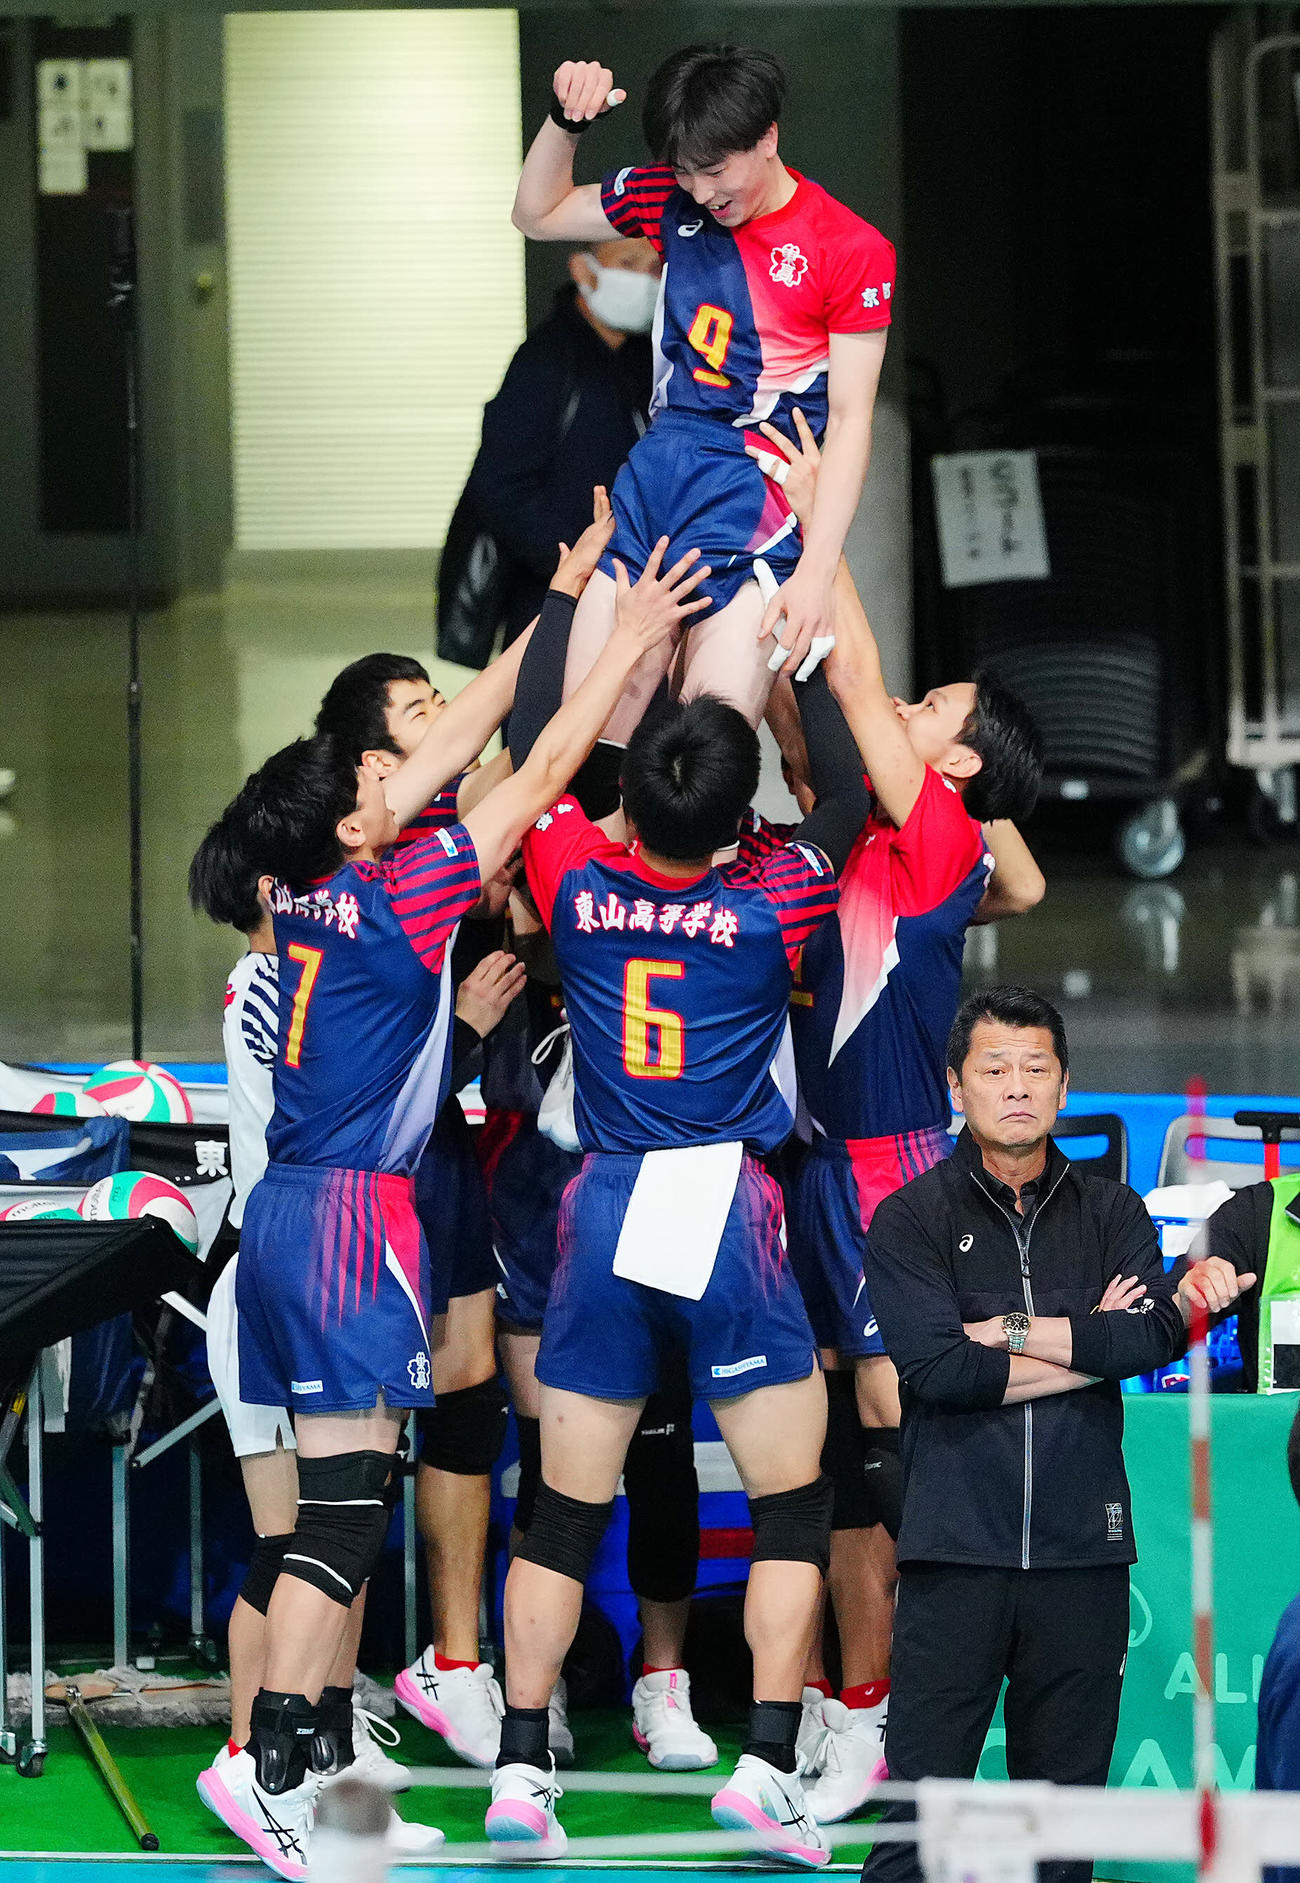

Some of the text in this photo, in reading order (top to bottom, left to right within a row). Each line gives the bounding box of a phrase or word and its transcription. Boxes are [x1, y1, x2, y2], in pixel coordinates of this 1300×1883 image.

[687, 303, 734, 389] 9
[574, 890, 739, 948] 東山高等学校
[285, 941, 324, 1068] 7
[622, 957, 685, 1080] 6
[195, 1140, 229, 1177] 東
